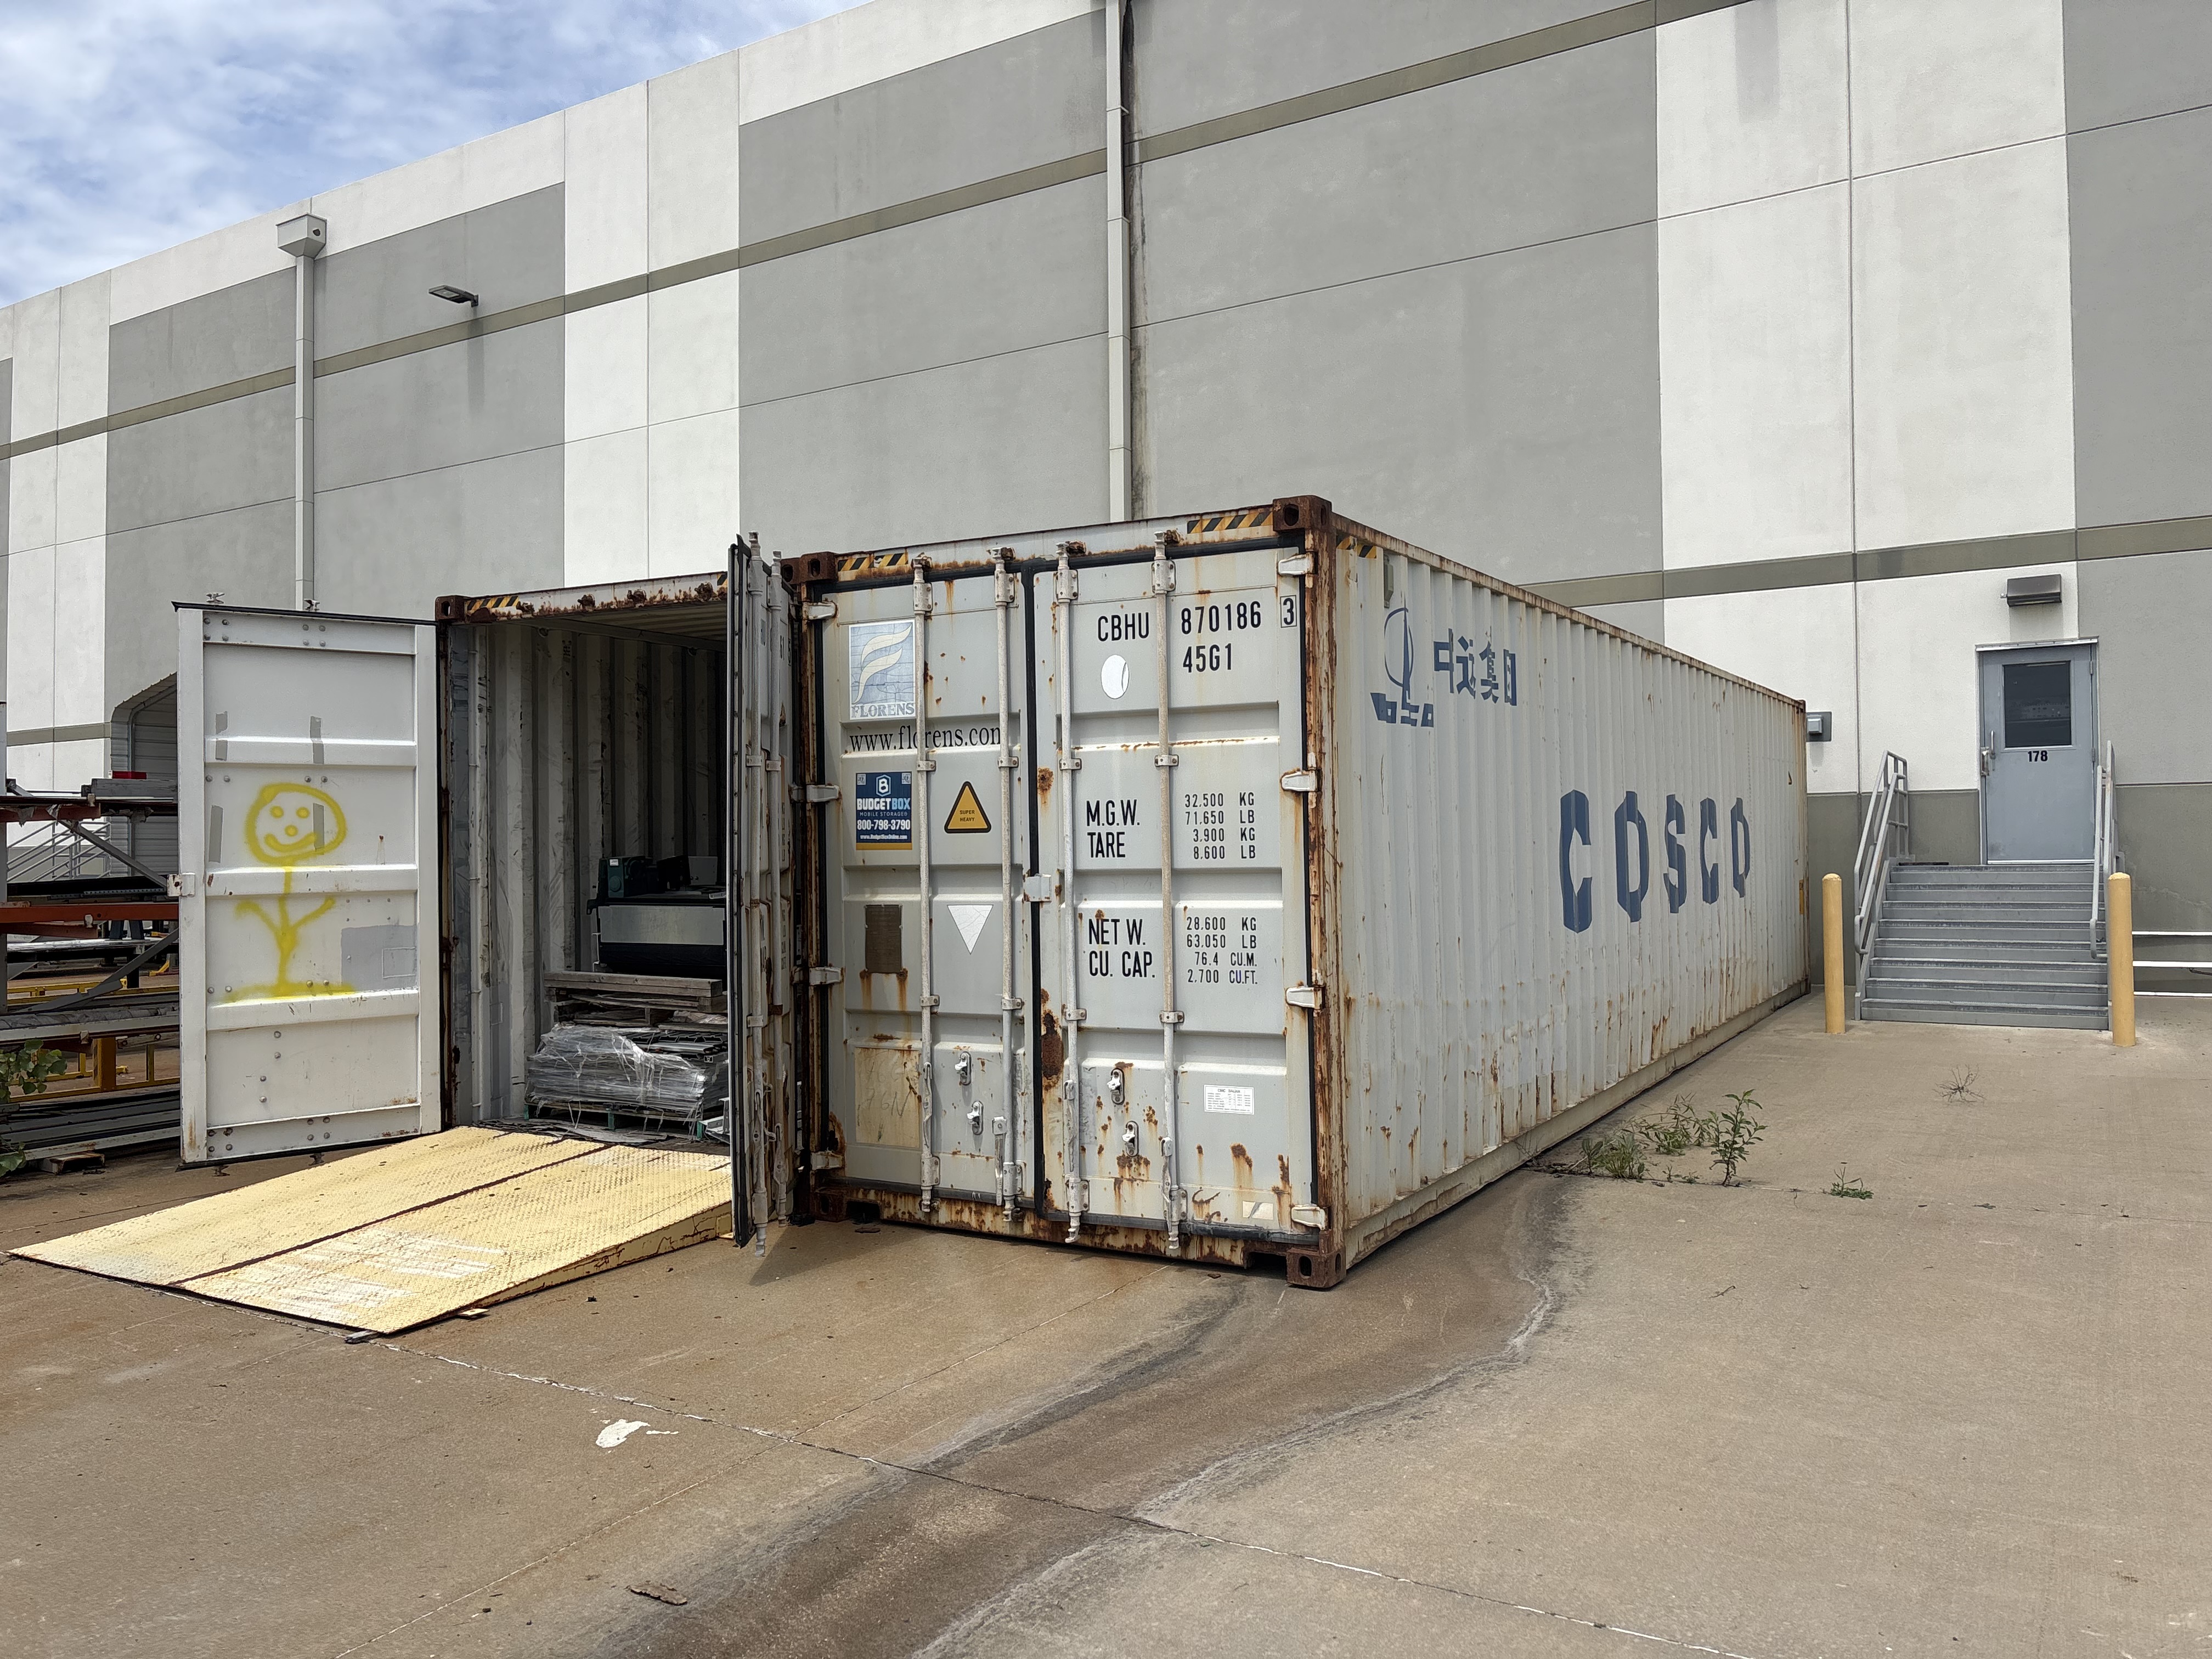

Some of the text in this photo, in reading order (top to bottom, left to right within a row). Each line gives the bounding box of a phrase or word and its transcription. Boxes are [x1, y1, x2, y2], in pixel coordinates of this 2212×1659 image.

[1098, 597, 1295, 642] CBHU 870186 3
[1183, 643, 1232, 673] 45G1
[851, 702, 915, 718] FLORENS
[2027, 750, 2048, 762] 178
[1184, 792, 1254, 808] 32,500 KG
[1086, 799, 1140, 827] M.G.W.
[1185, 809, 1255, 825] 71,650 LB
[857, 819, 911, 831] 800-798-3790
[1193, 827, 1255, 842] 3,900 KG
[1087, 831, 1126, 858] TARE
[1193, 844, 1256, 860] 8,600 LB
[1559, 789, 1751, 934] COSCO
[1088, 918, 1146, 945] NET W.
[1186, 916, 1256, 931] 28,600 KG
[1187, 934, 1257, 949] 63,050 LB
[1089, 950, 1155, 978] CU. CAP.
[1194, 951, 1257, 967] 76.4 CU.M.
[1187, 969, 1258, 985] 2,700 CU.FT.
